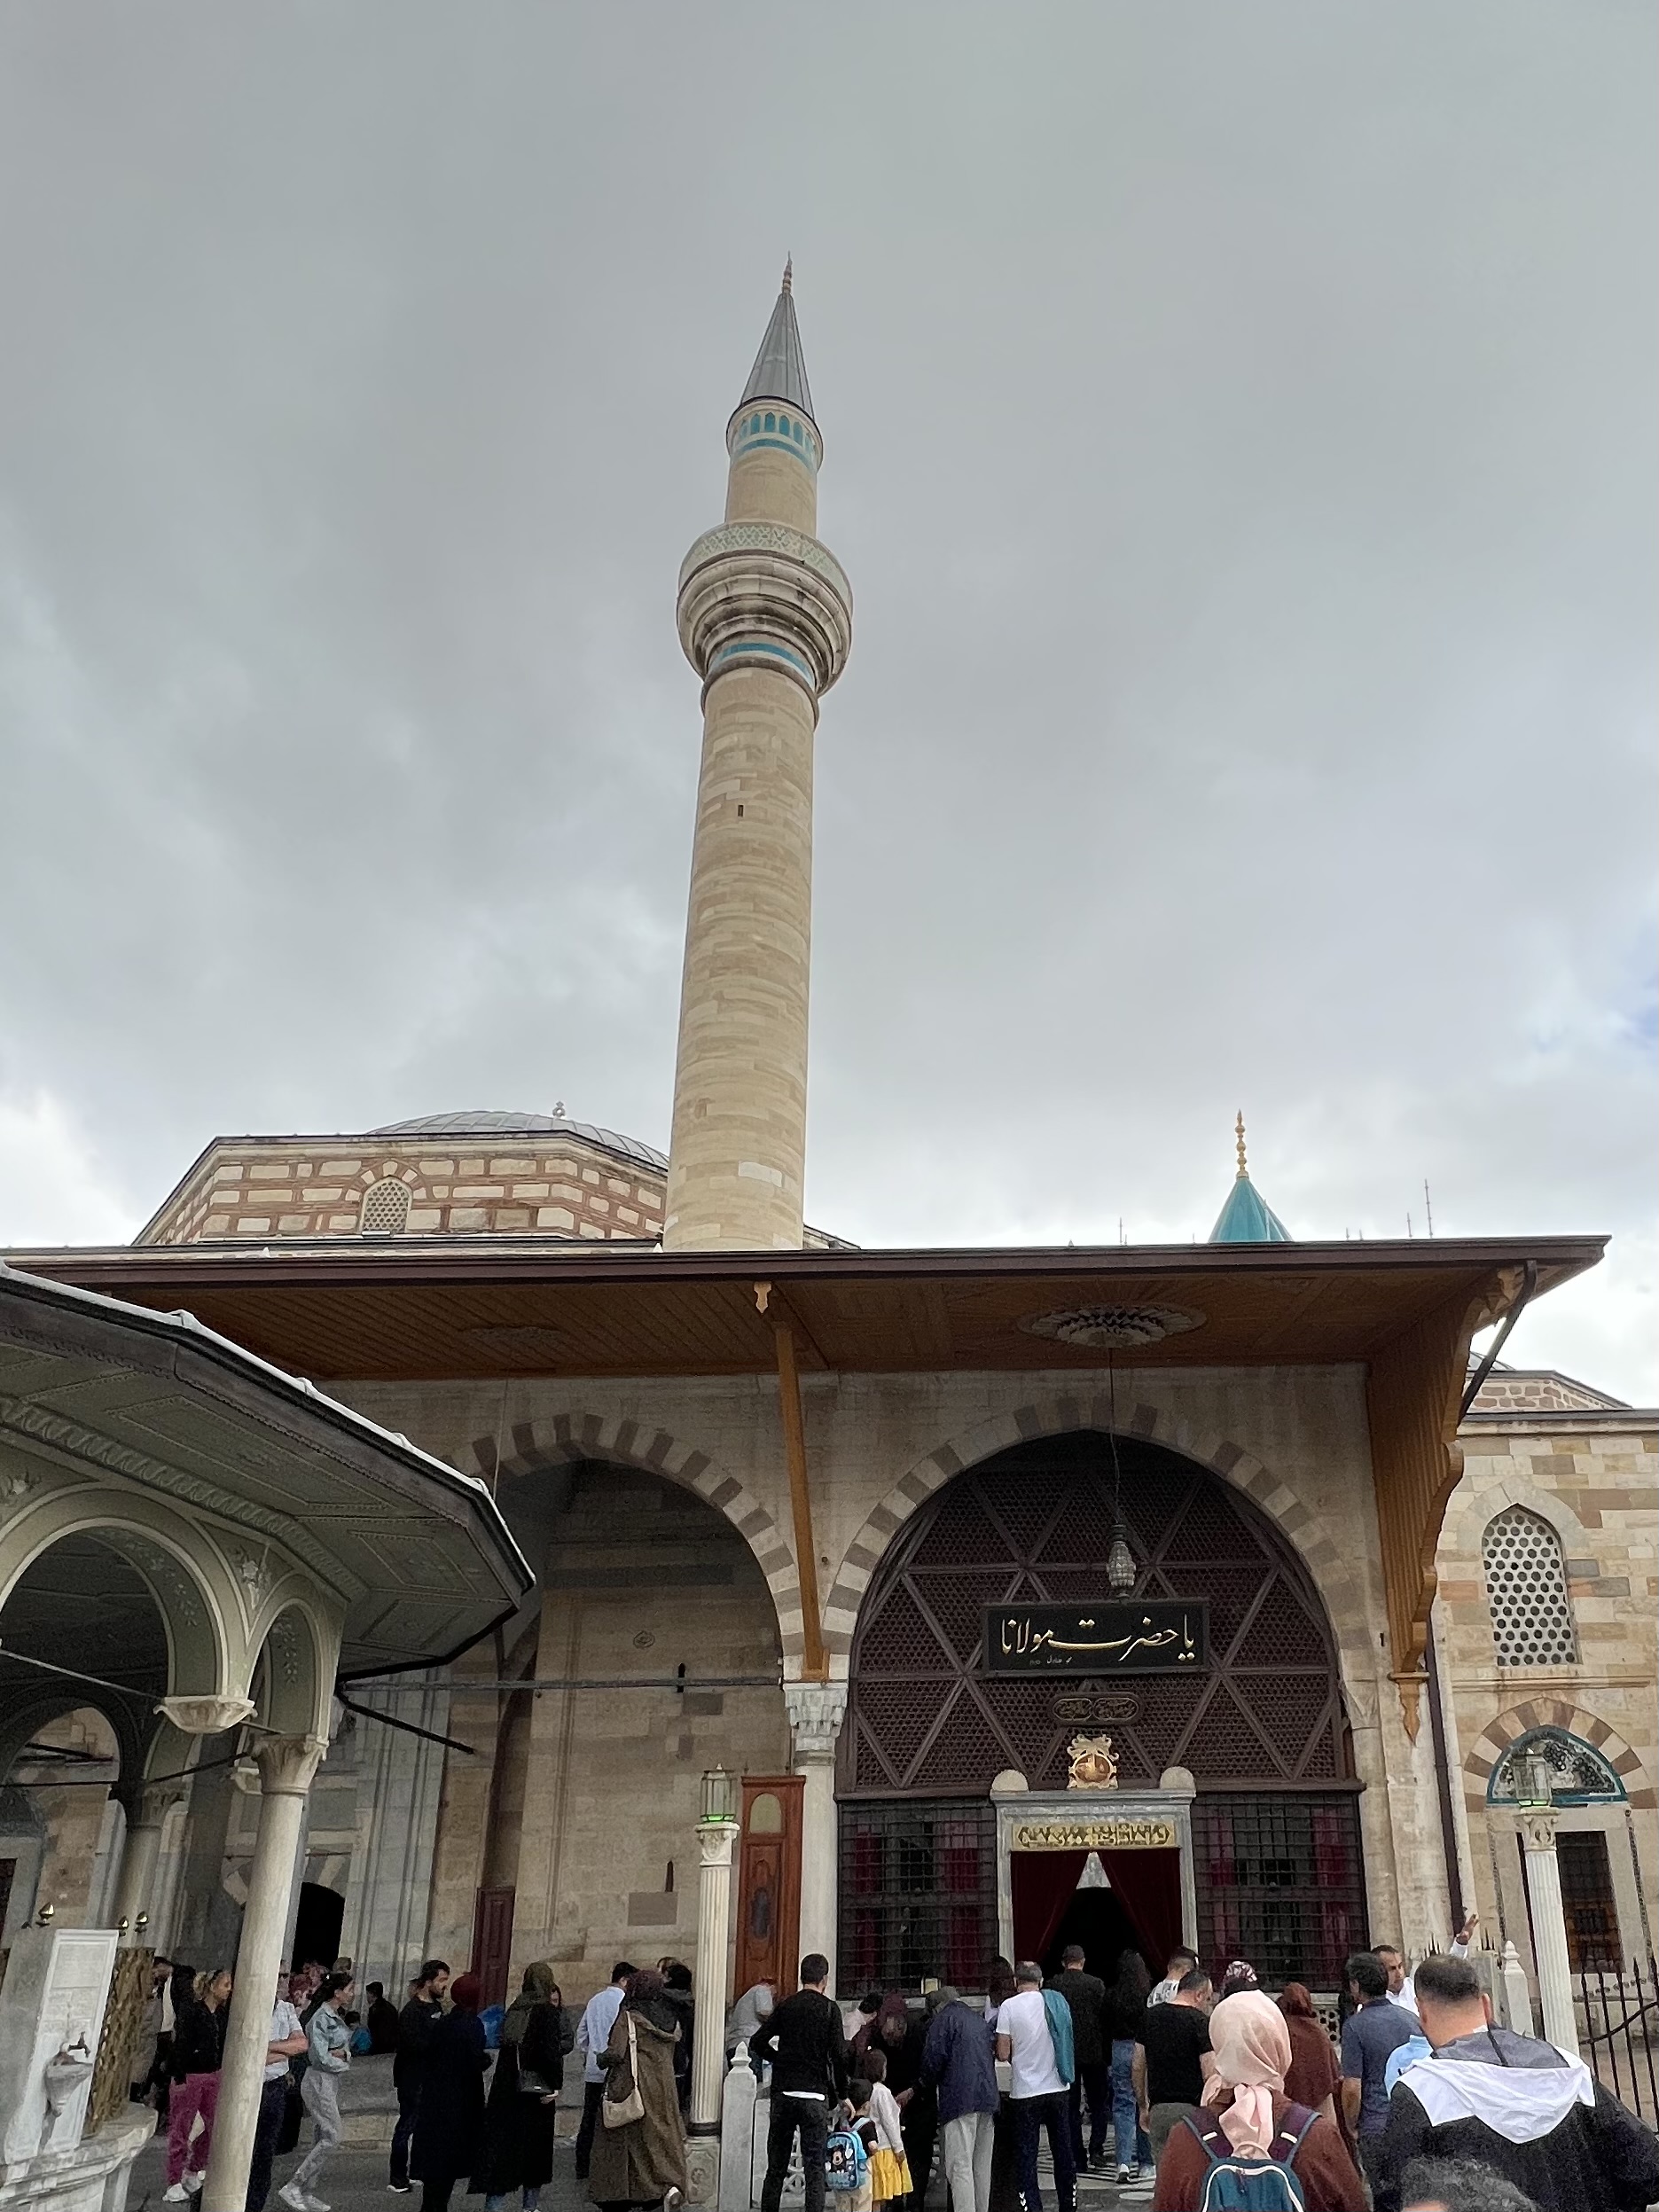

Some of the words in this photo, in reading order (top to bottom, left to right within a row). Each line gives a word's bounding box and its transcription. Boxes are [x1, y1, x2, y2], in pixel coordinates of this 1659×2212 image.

[1001, 1617, 1054, 1655] مولانا
[1047, 1615, 1180, 1661] حضرت
[1178, 1614, 1195, 1661] يا
